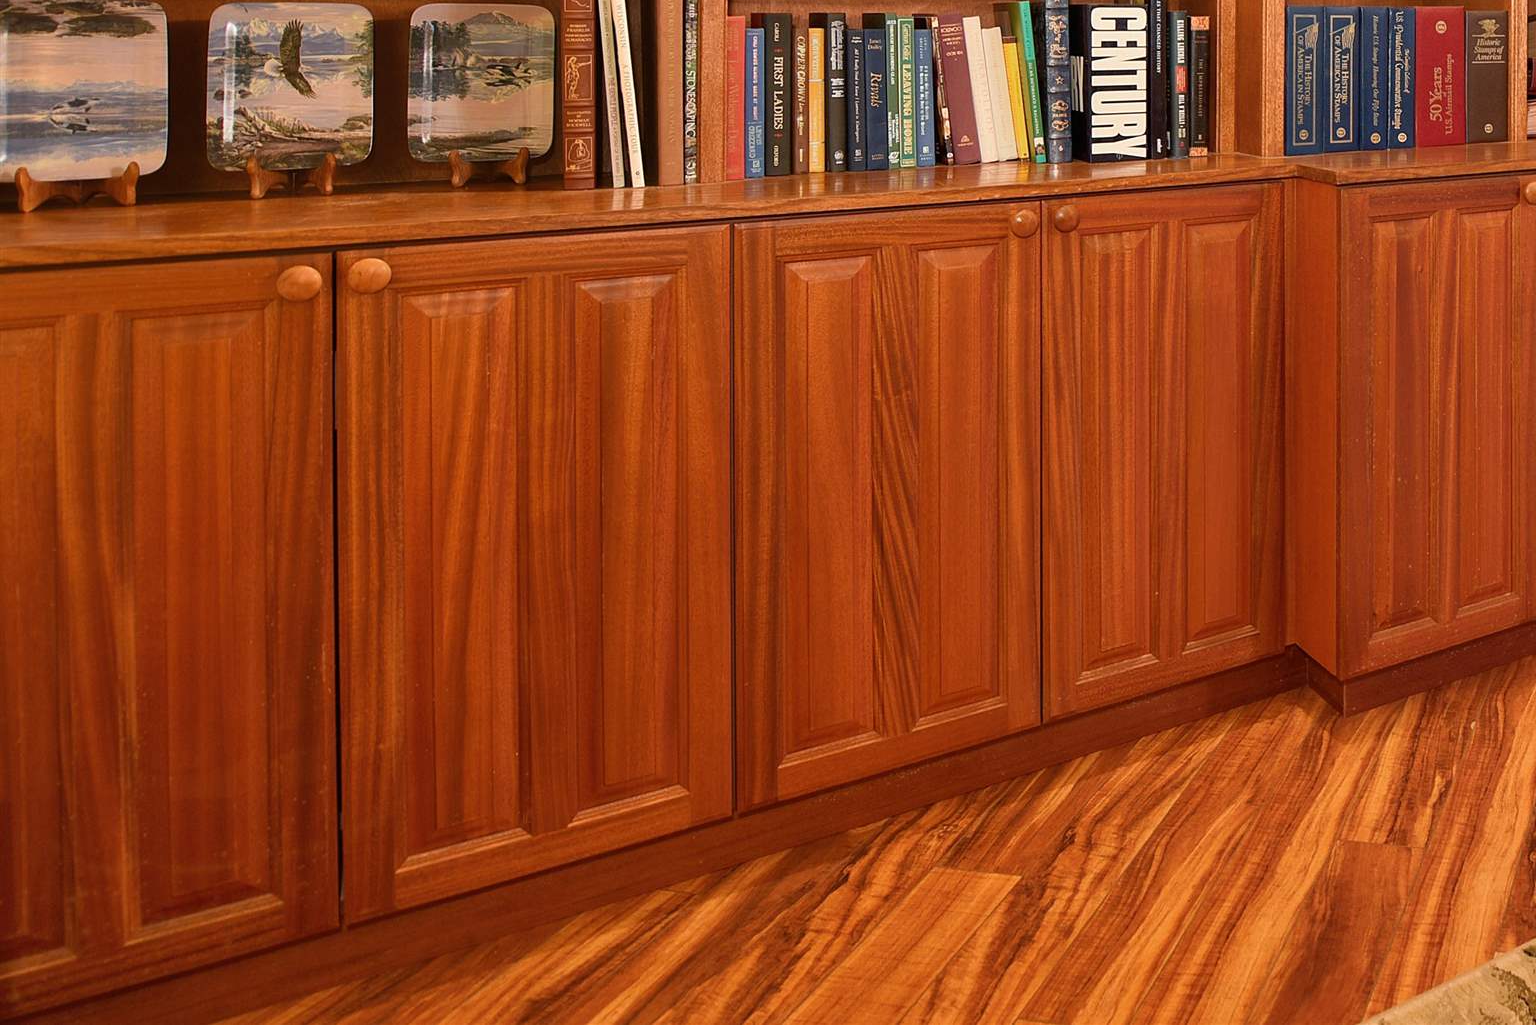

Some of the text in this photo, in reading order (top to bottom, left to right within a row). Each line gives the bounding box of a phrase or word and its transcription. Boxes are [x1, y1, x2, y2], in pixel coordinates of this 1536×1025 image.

[617, 3, 627, 48] WISCONSIN
[1298, 36, 1304, 45] OF
[1335, 36, 1341, 45] OF
[1473, 46, 1497, 54] Stamps
[773, 56, 784, 130] FIRST LADIES
[797, 36, 806, 102] COPPER CROWN
[870, 73, 882, 108] Rivals
[1091, 7, 1147, 158] CENTURY
[1429, 67, 1442, 122] 50 Years
[1445, 54, 1454, 135] U.S. Airmail Stamps
[685, 70, 697, 137] STONESCAPING
[903, 64, 912, 154] LEAVING HOME
